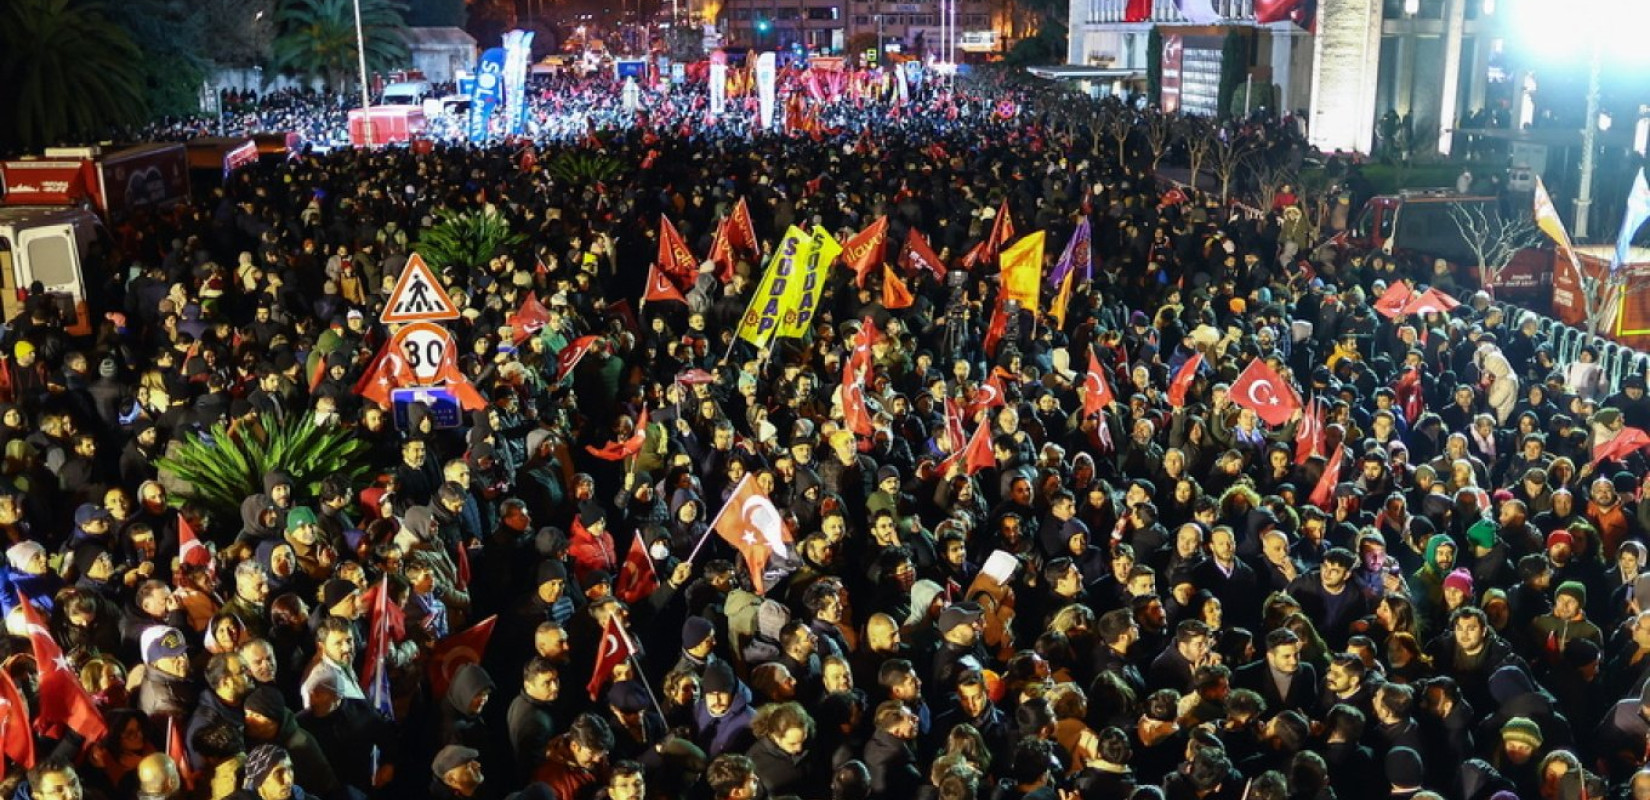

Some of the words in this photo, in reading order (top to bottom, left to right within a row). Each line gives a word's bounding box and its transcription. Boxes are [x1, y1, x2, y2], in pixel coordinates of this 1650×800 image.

[475, 60, 499, 99] SOL
[757, 236, 800, 334] SODAP
[796, 233, 825, 329] SODAP
[405, 340, 443, 369] 30
